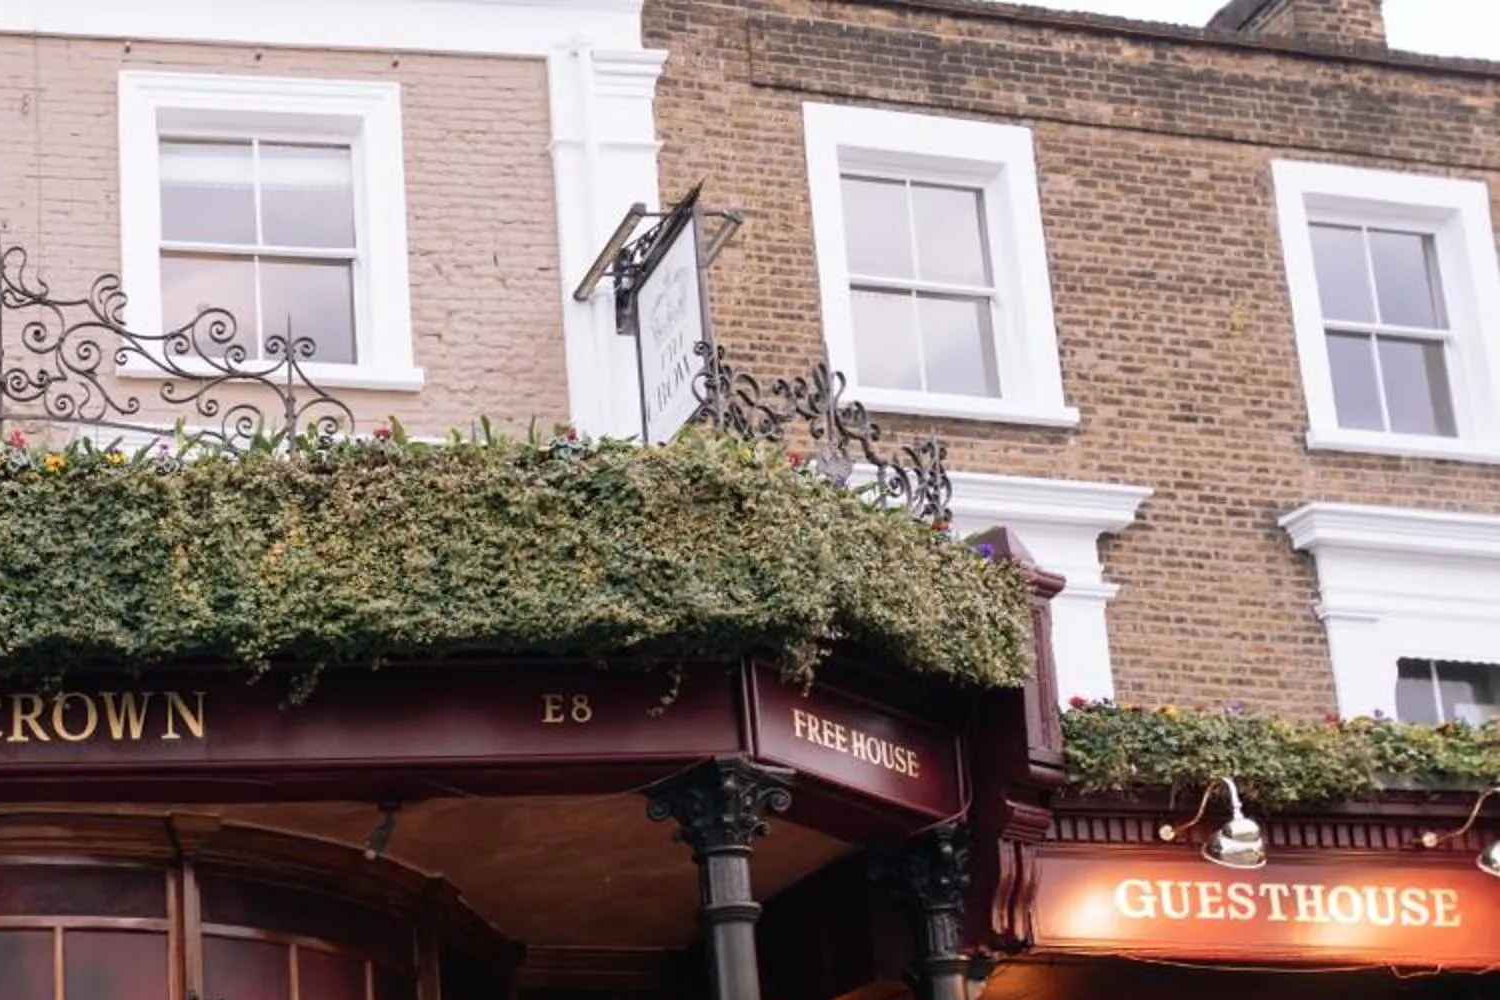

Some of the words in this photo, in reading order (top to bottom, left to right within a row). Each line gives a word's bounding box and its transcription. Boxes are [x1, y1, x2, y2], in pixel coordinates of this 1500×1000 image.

[542, 695, 593, 723] E8
[793, 708, 848, 752] FREE
[851, 731, 921, 779] HOUSE
[1114, 879, 1462, 927] GUESTHOUSE
